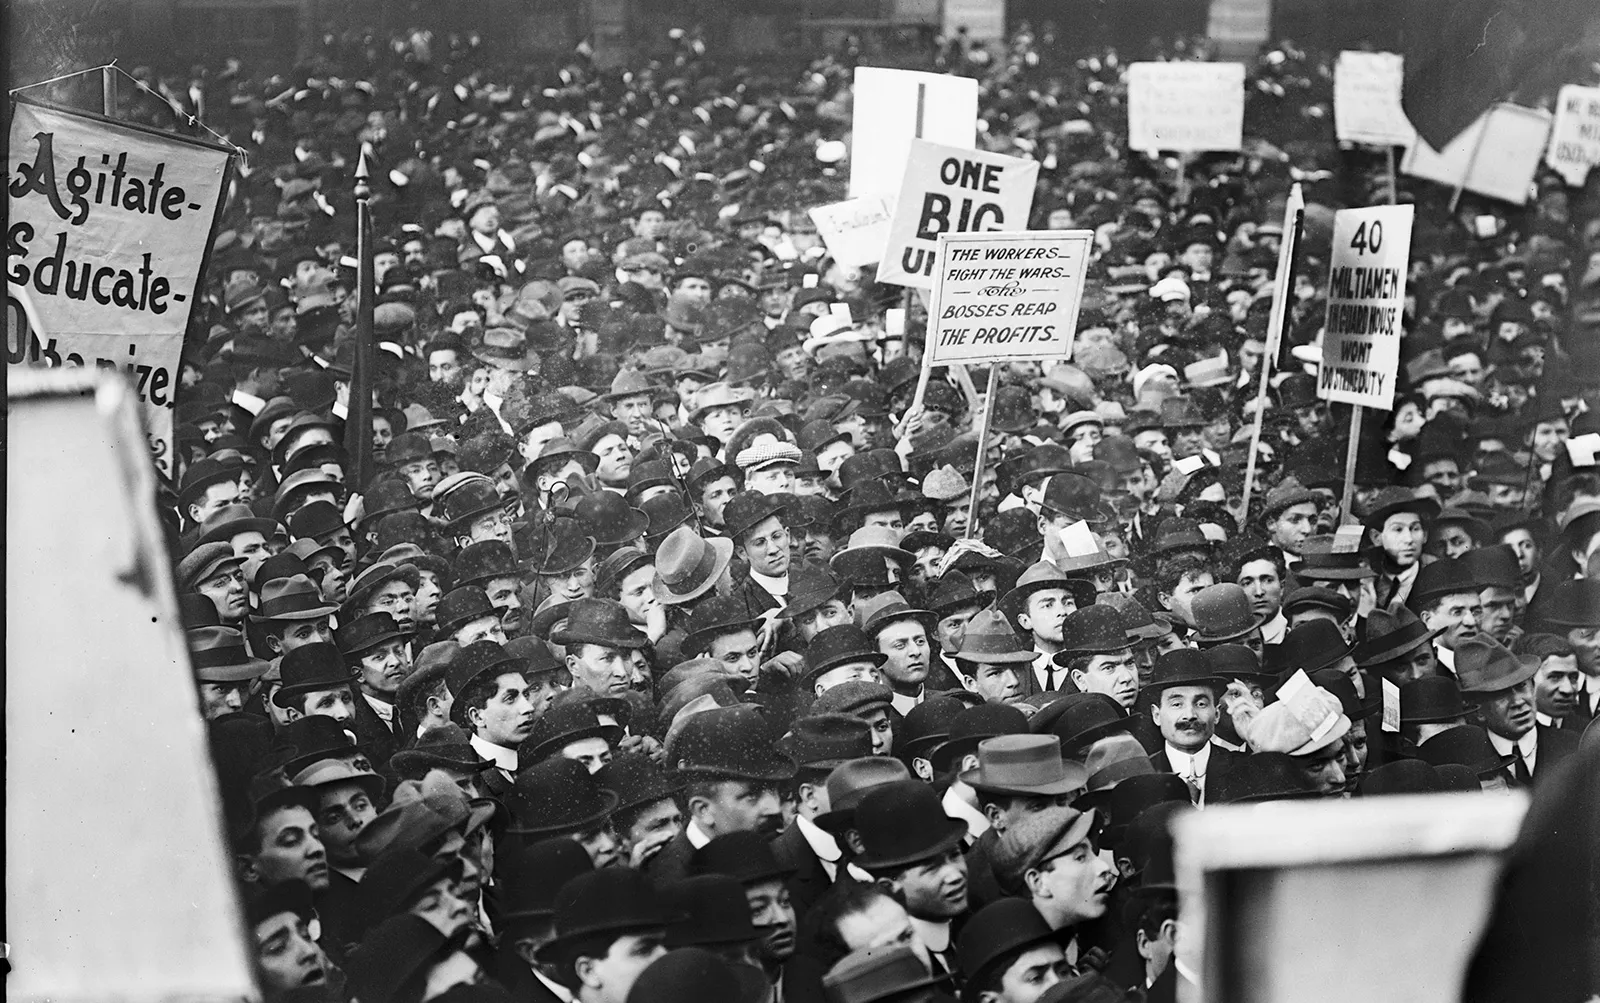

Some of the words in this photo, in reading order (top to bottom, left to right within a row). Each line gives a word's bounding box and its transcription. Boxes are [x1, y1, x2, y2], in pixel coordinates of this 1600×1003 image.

[940, 157, 1004, 194] ONE
[916, 192, 1005, 240] BIG
[1351, 220, 1382, 256] 40
[951, 248, 981, 261] THE
[947, 268, 988, 281] FIGHT
[988, 268, 1016, 280] THE
[977, 280, 1027, 297] The
[941, 303, 1009, 319] BOSSES
[1011, 302, 1057, 316] REAP
[940, 328, 970, 346] THE
[1341, 341, 1373, 364] WONT
